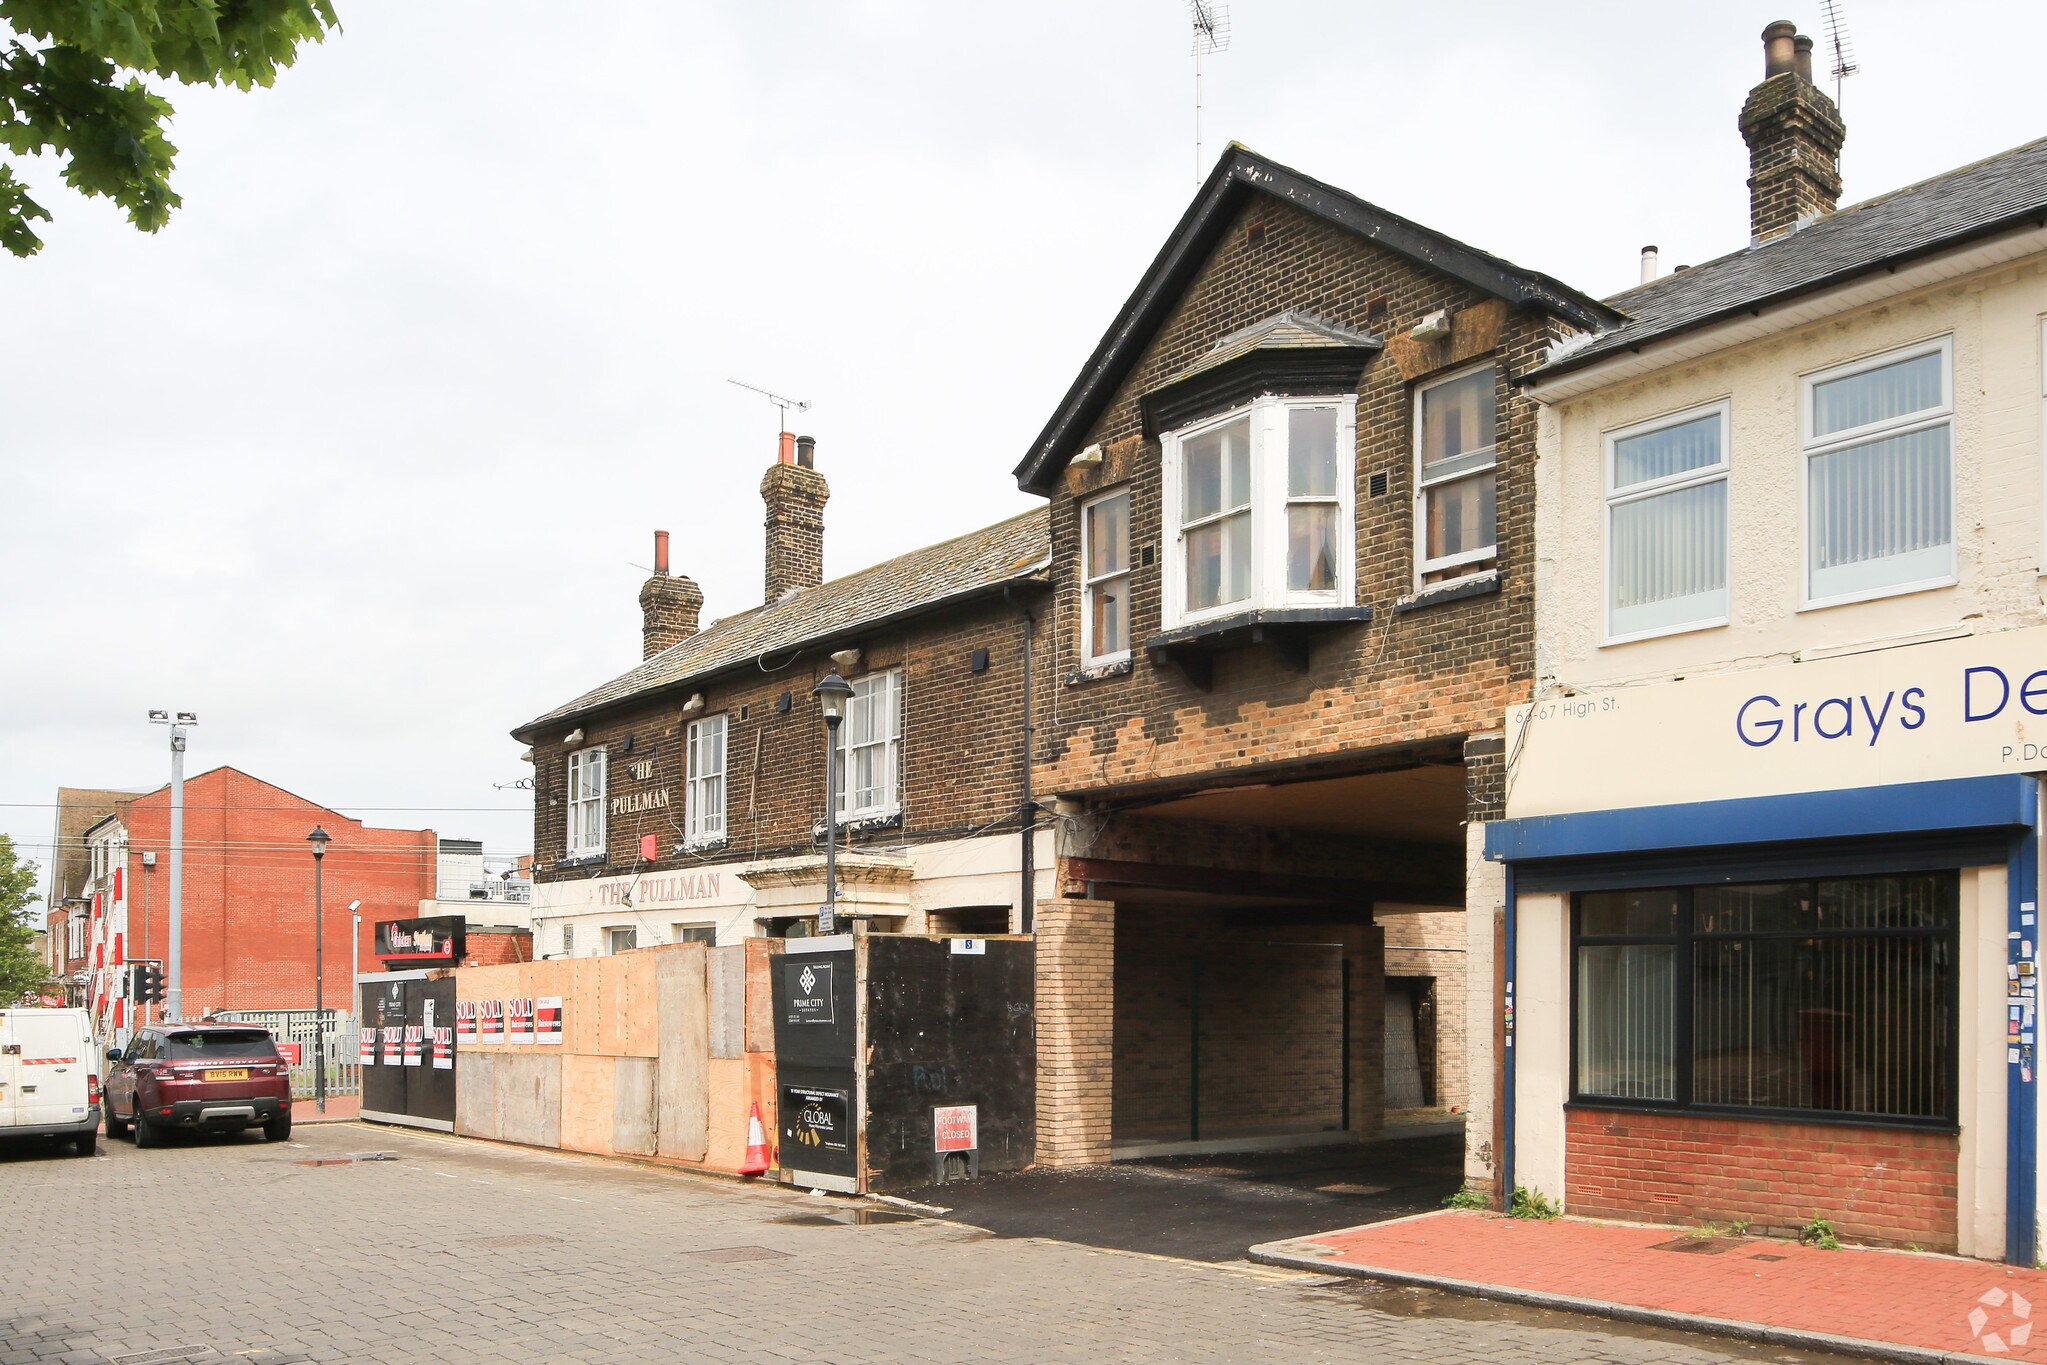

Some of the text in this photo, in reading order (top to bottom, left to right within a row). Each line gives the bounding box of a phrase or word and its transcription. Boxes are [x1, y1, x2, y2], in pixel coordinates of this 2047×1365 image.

[1563, 699, 1596, 718] High
[1602, 696, 1620, 711] St.
[1736, 687, 1926, 747] Grays
[631, 760, 653, 780] HE
[613, 788, 669, 816] PULLMAN
[639, 872, 721, 903] PULLMAN
[456, 1001, 476, 1020] SOLD
[480, 999, 503, 1019] SOLD
[510, 998, 533, 1018] SOLD
[794, 998, 823, 1007] PRIME CITY
[360, 1028, 376, 1044] SOLD
[384, 1027, 403, 1044] SOLD
[405, 1025, 423, 1043] SOLD
[433, 1027, 453, 1045] SOLD
[803, 1110, 834, 1126] GLOBAL
[942, 1130, 970, 1140] CLOSED
